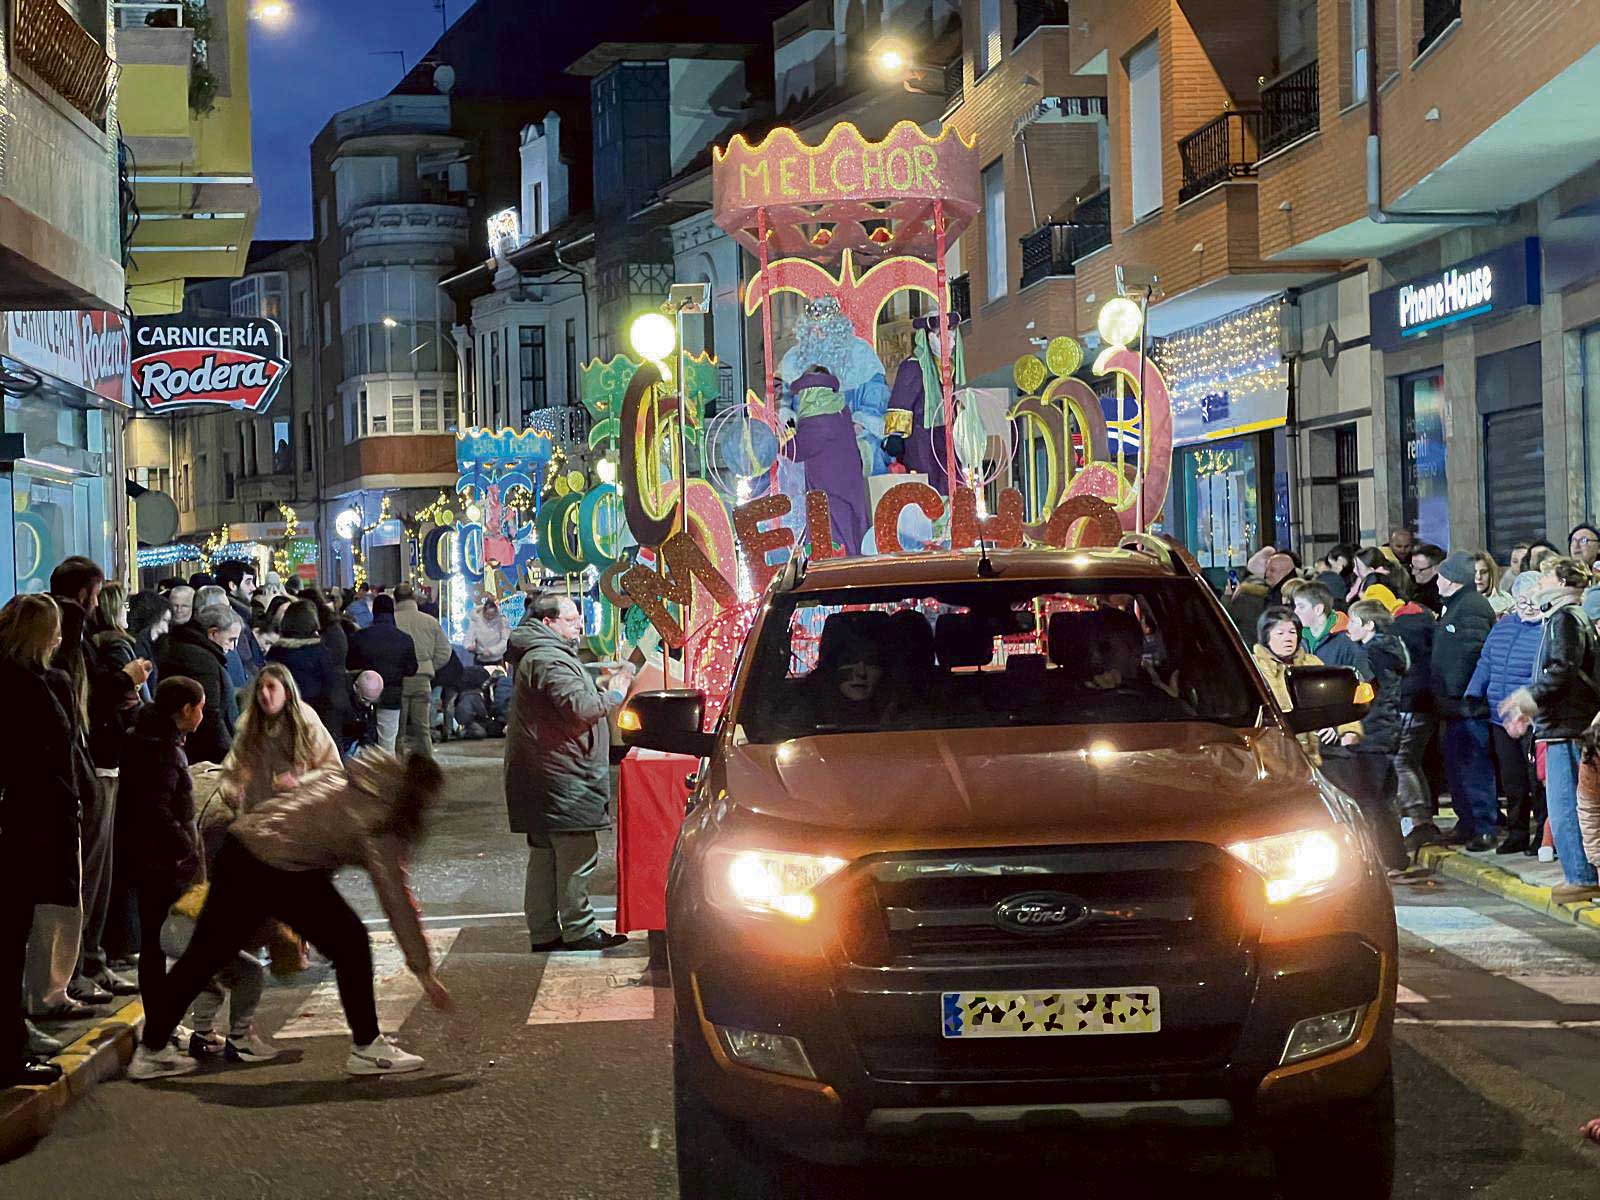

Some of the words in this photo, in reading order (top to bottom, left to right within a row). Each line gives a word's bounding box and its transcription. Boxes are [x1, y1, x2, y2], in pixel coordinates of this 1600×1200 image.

[739, 144, 942, 199] MELCHOR
[137, 323, 270, 347] CARNICERÍA
[141, 354, 269, 400] Rodera
[1016, 902, 1067, 924] Ford
